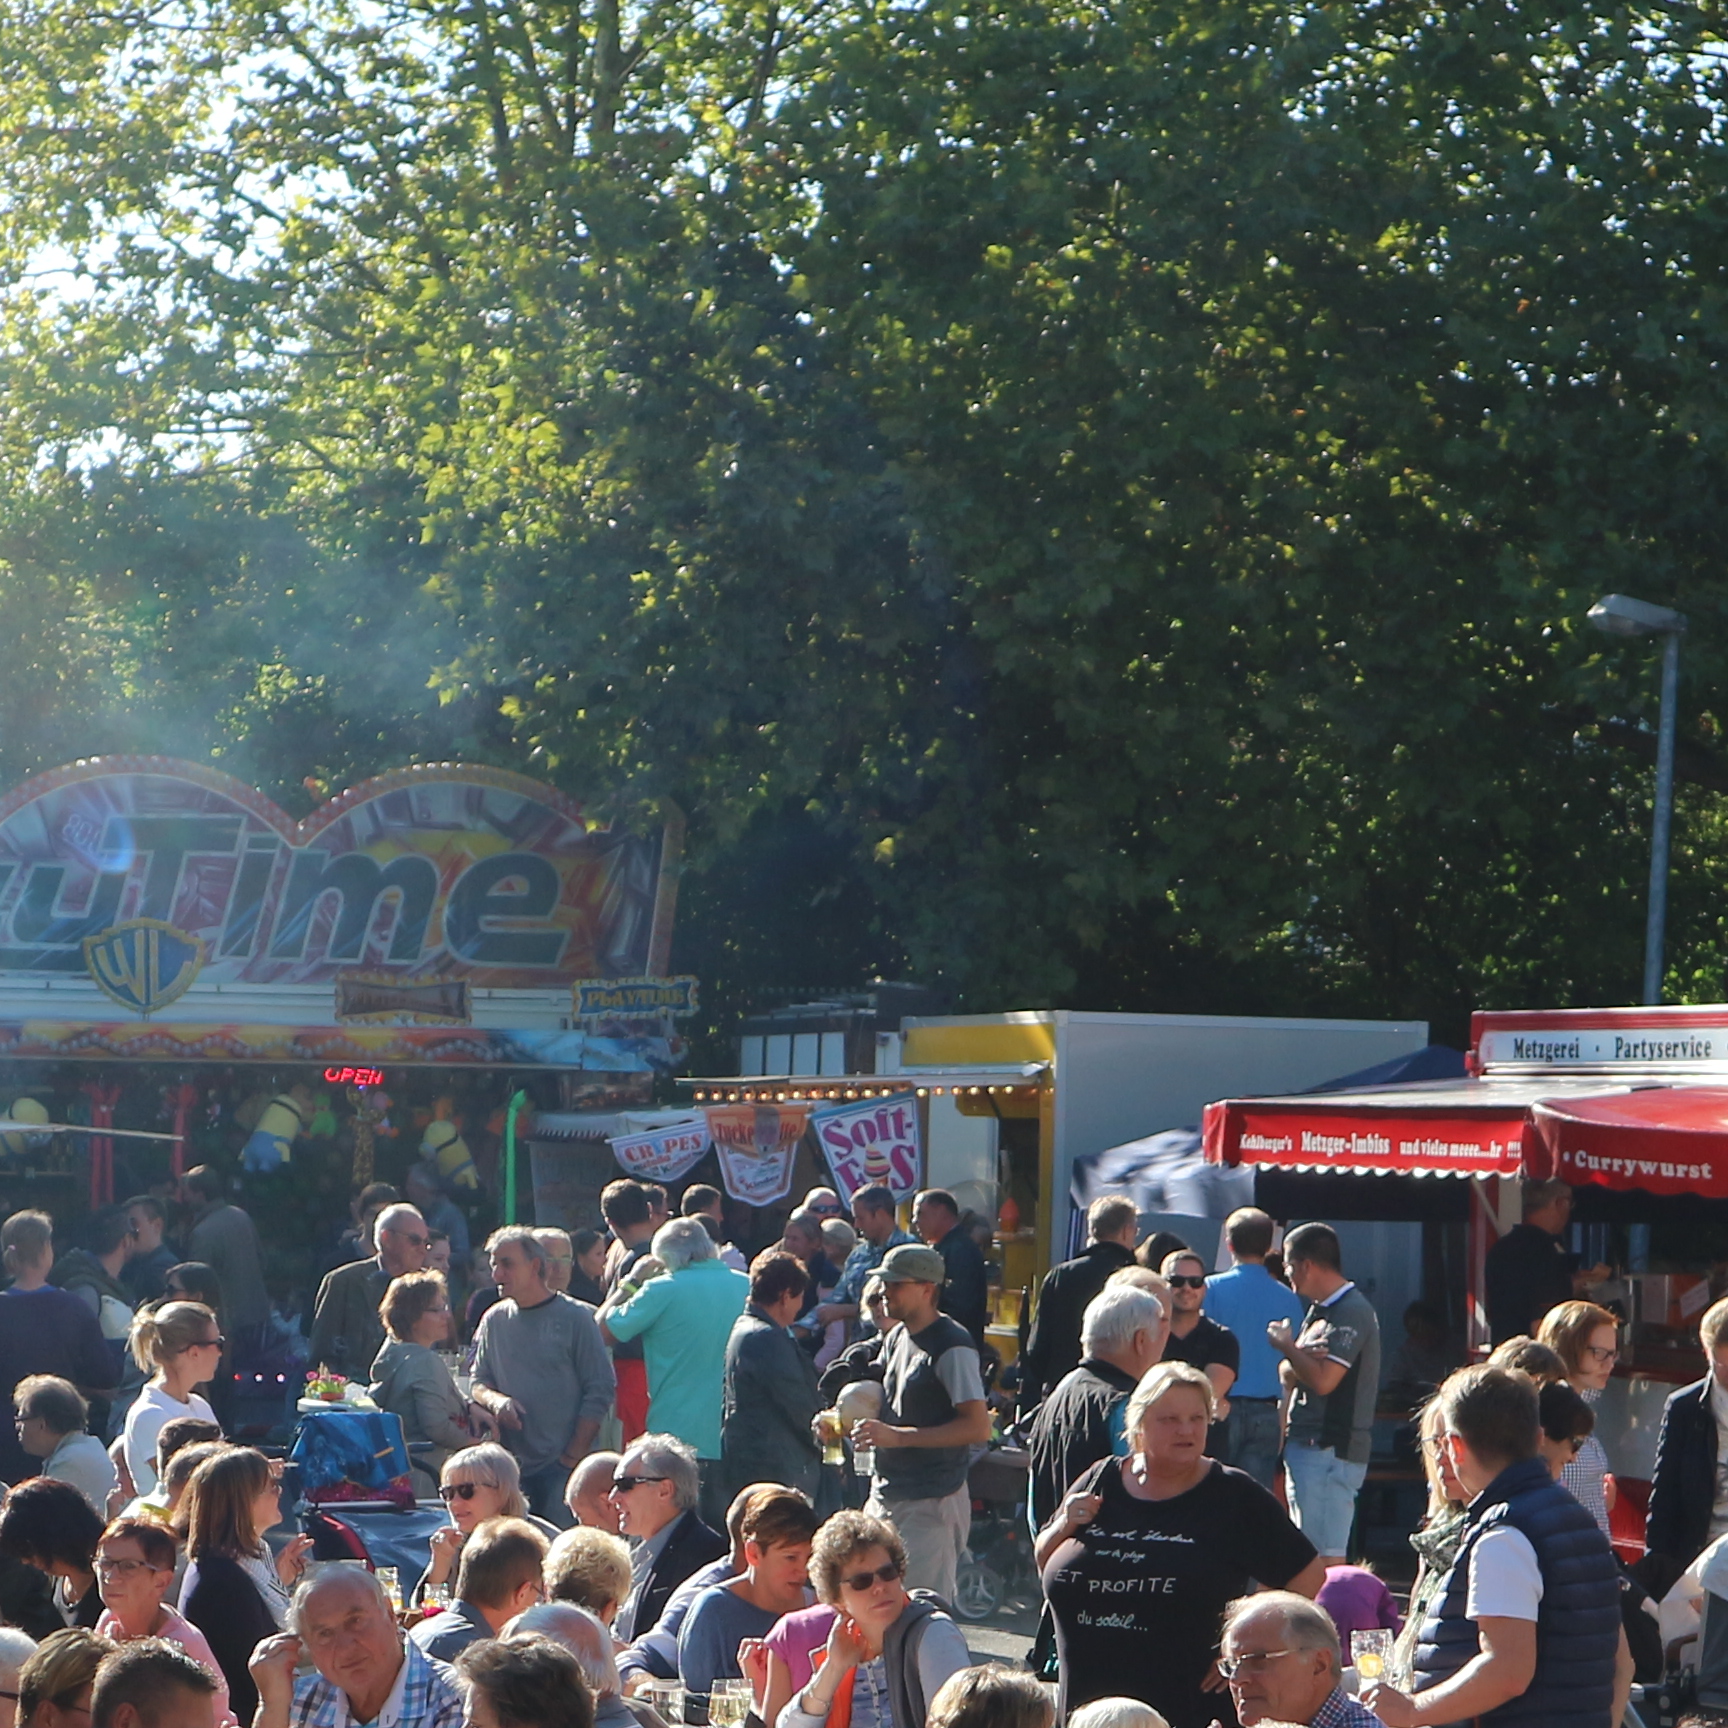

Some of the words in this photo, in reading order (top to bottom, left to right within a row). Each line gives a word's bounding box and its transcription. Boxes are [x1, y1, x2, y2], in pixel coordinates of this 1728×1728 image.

[1513, 1037, 1581, 1061] Metzgerei
[1614, 1035, 1712, 1061] Partyservice
[324, 1066, 383, 1085] OPEN
[1400, 1138, 1420, 1155] und
[1421, 1138, 1448, 1156] vieles
[1574, 1150, 1712, 1179] Currywurst
[1054, 1569, 1083, 1584] ET
[1088, 1577, 1177, 1594] PROFITE
[1077, 1610, 1092, 1625] du
